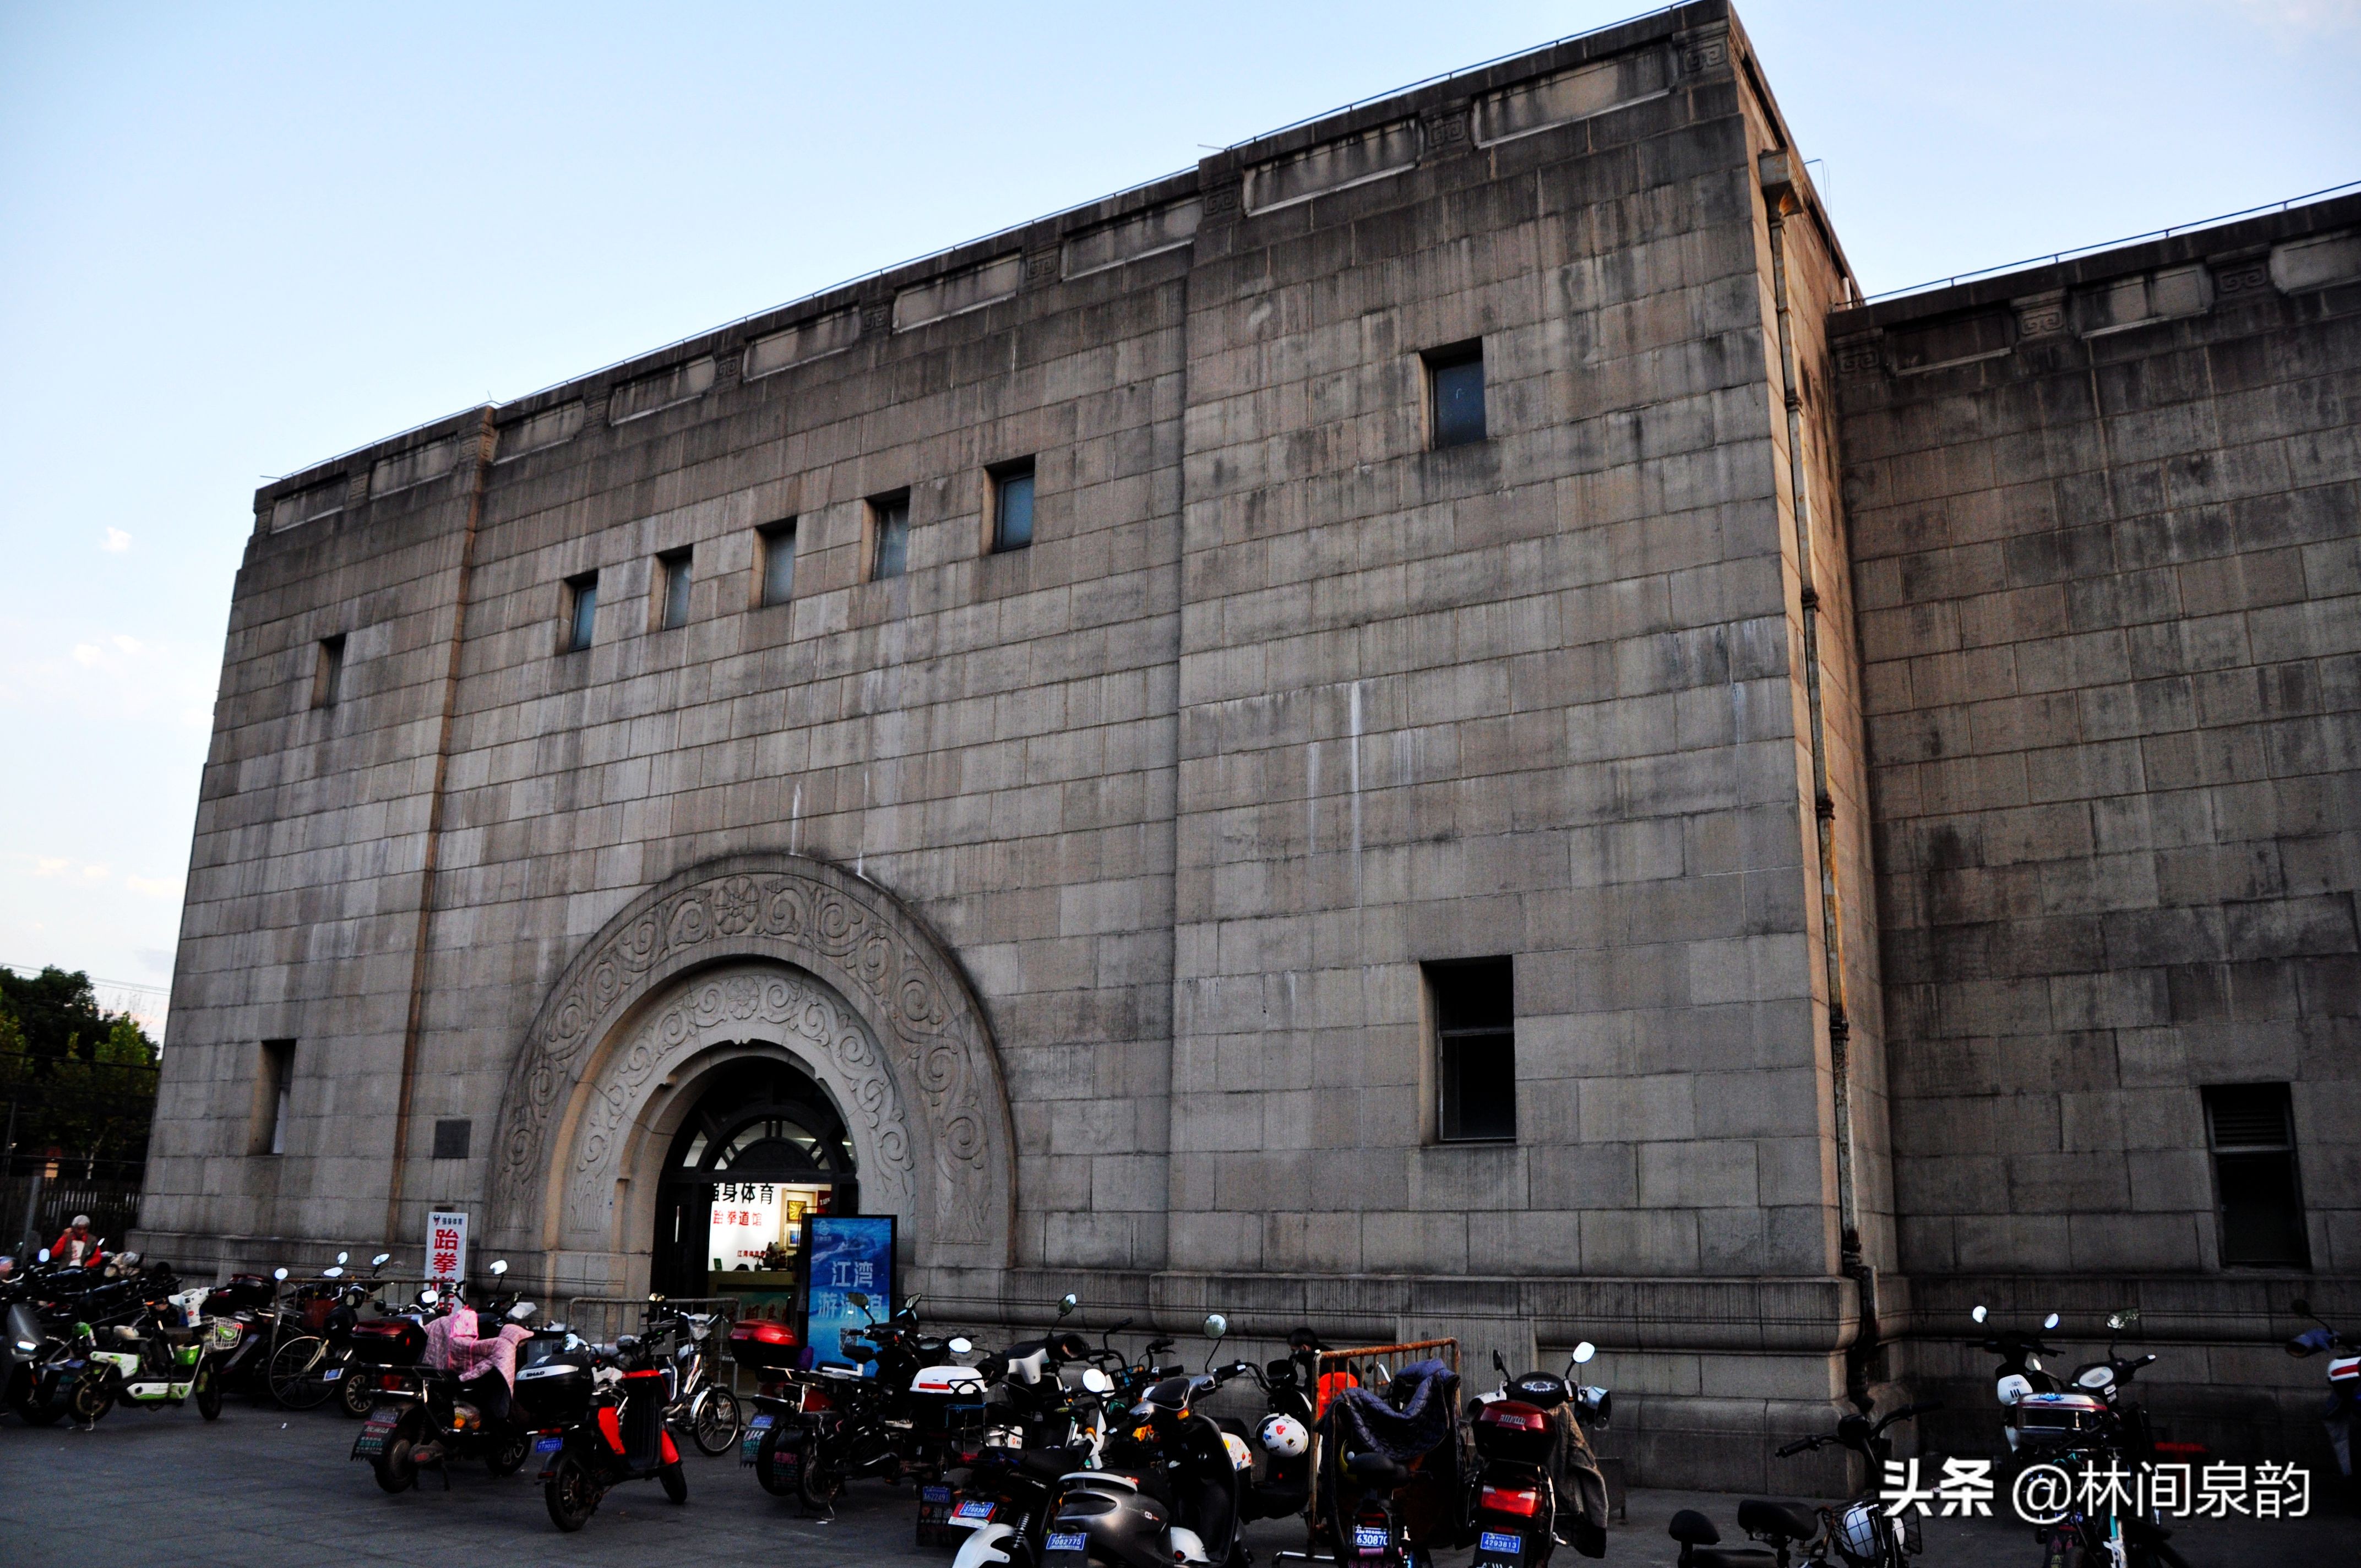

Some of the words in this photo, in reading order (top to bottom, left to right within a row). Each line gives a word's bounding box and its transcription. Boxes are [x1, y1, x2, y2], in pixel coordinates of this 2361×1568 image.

[712, 1209, 763, 1227] 跆拳道馆
[831, 1261, 874, 1288] 江湾
[1484, 1539, 1517, 1549] 4293813
